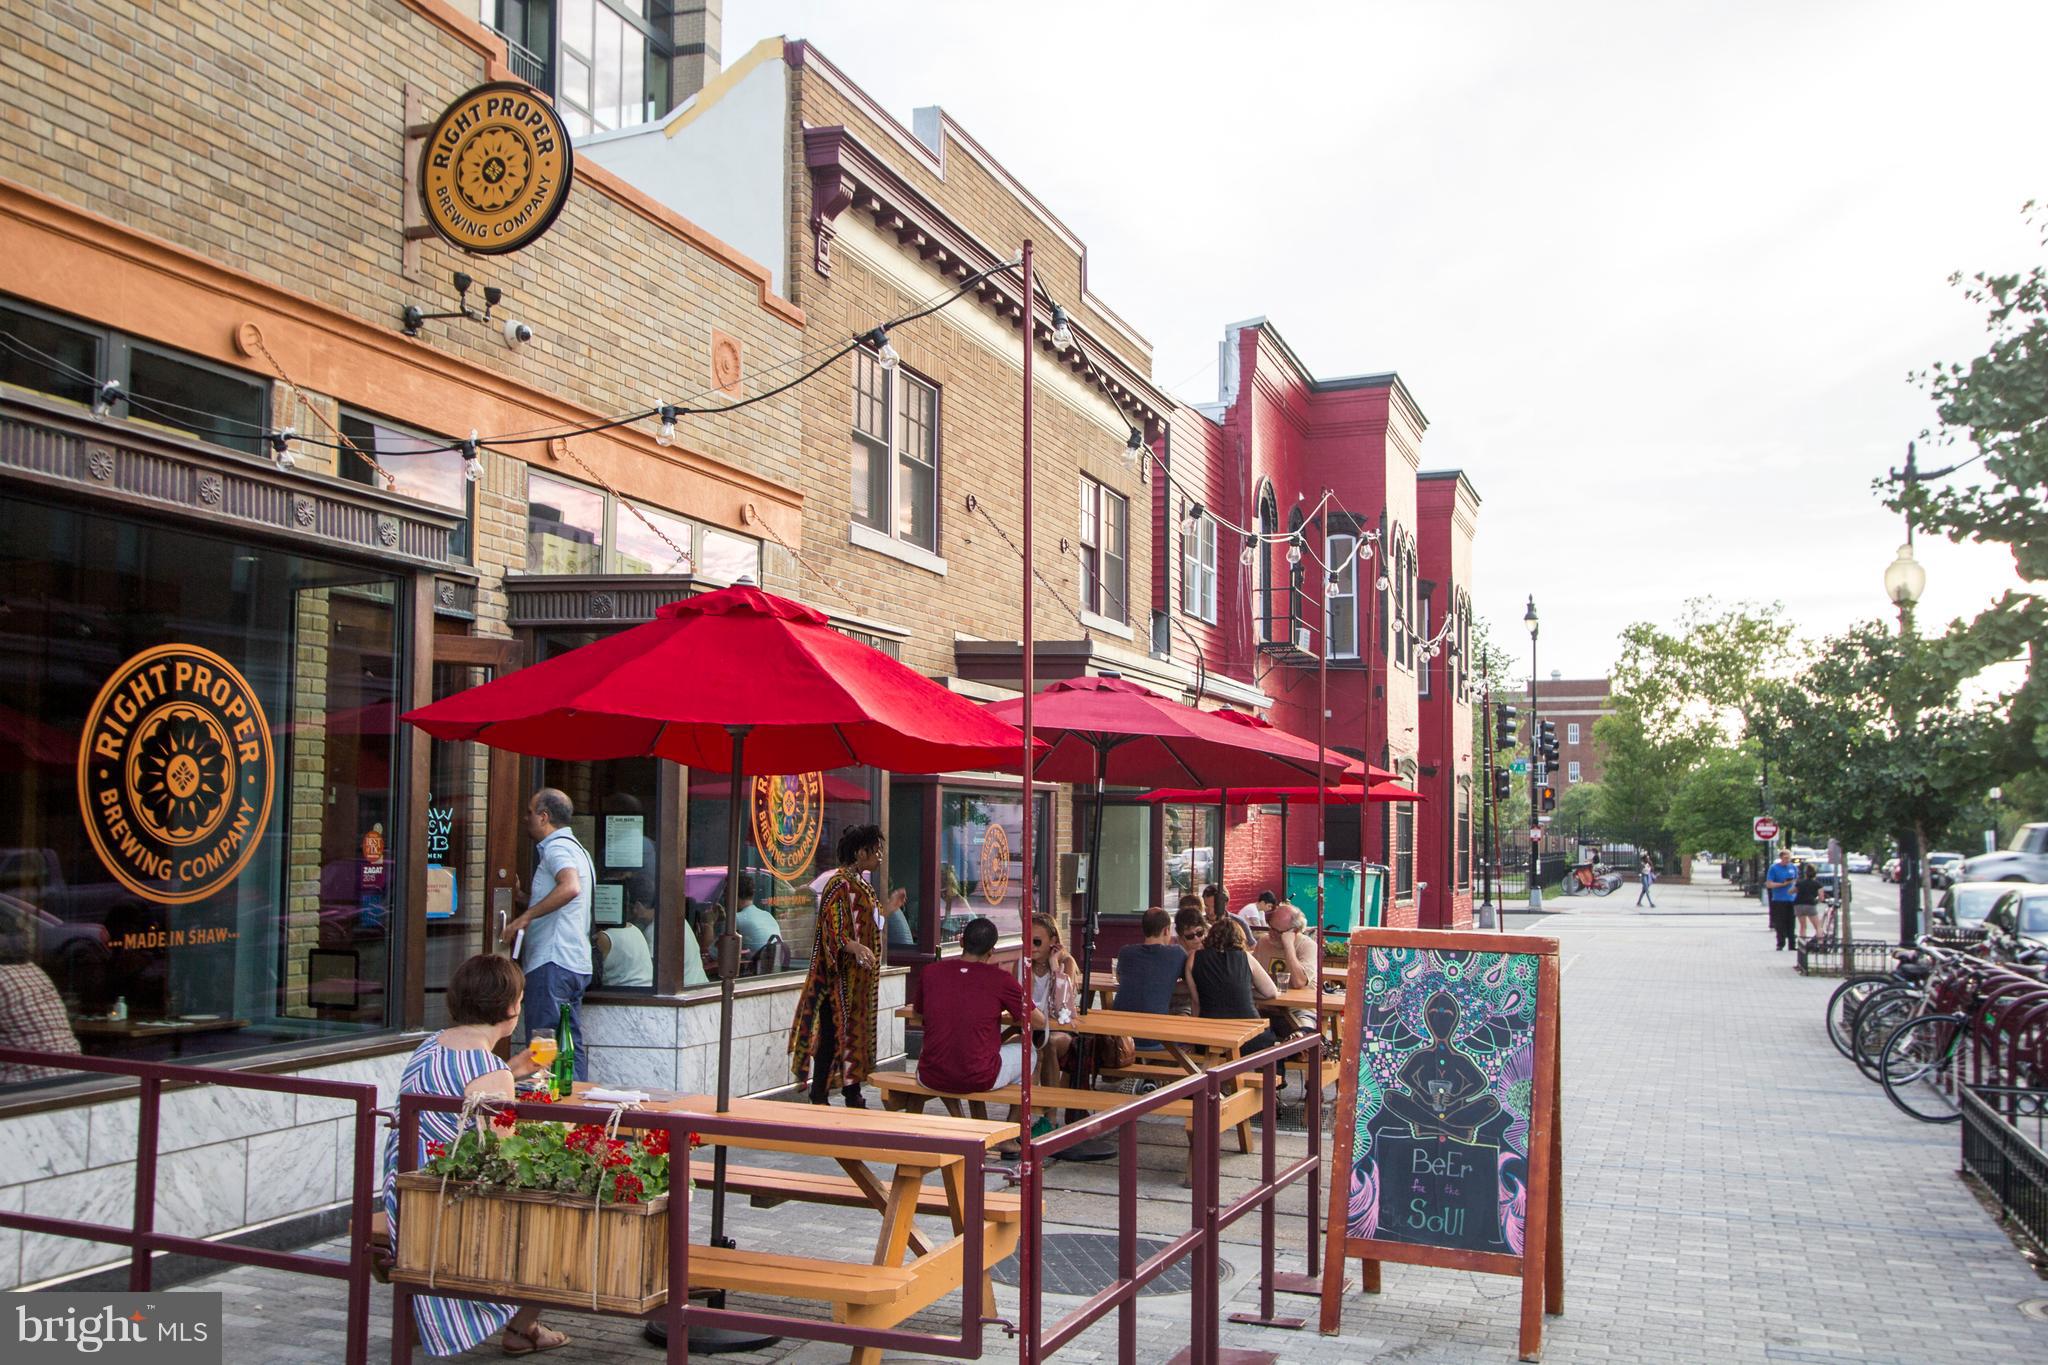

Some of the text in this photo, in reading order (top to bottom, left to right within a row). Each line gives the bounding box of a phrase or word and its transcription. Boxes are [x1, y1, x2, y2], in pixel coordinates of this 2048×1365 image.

[433, 97, 555, 169] RIGHT PROPER
[436, 174, 552, 238] BREWING COMPANY
[95, 661, 260, 765] RIGHT PROPER
[99, 787, 256, 882] BREWING COMPANY
[759, 810, 816, 867] BREWING COMPANY
[363, 866, 383, 874] ZAGAT
[124, 928, 229, 949] MADE IN SHAW
